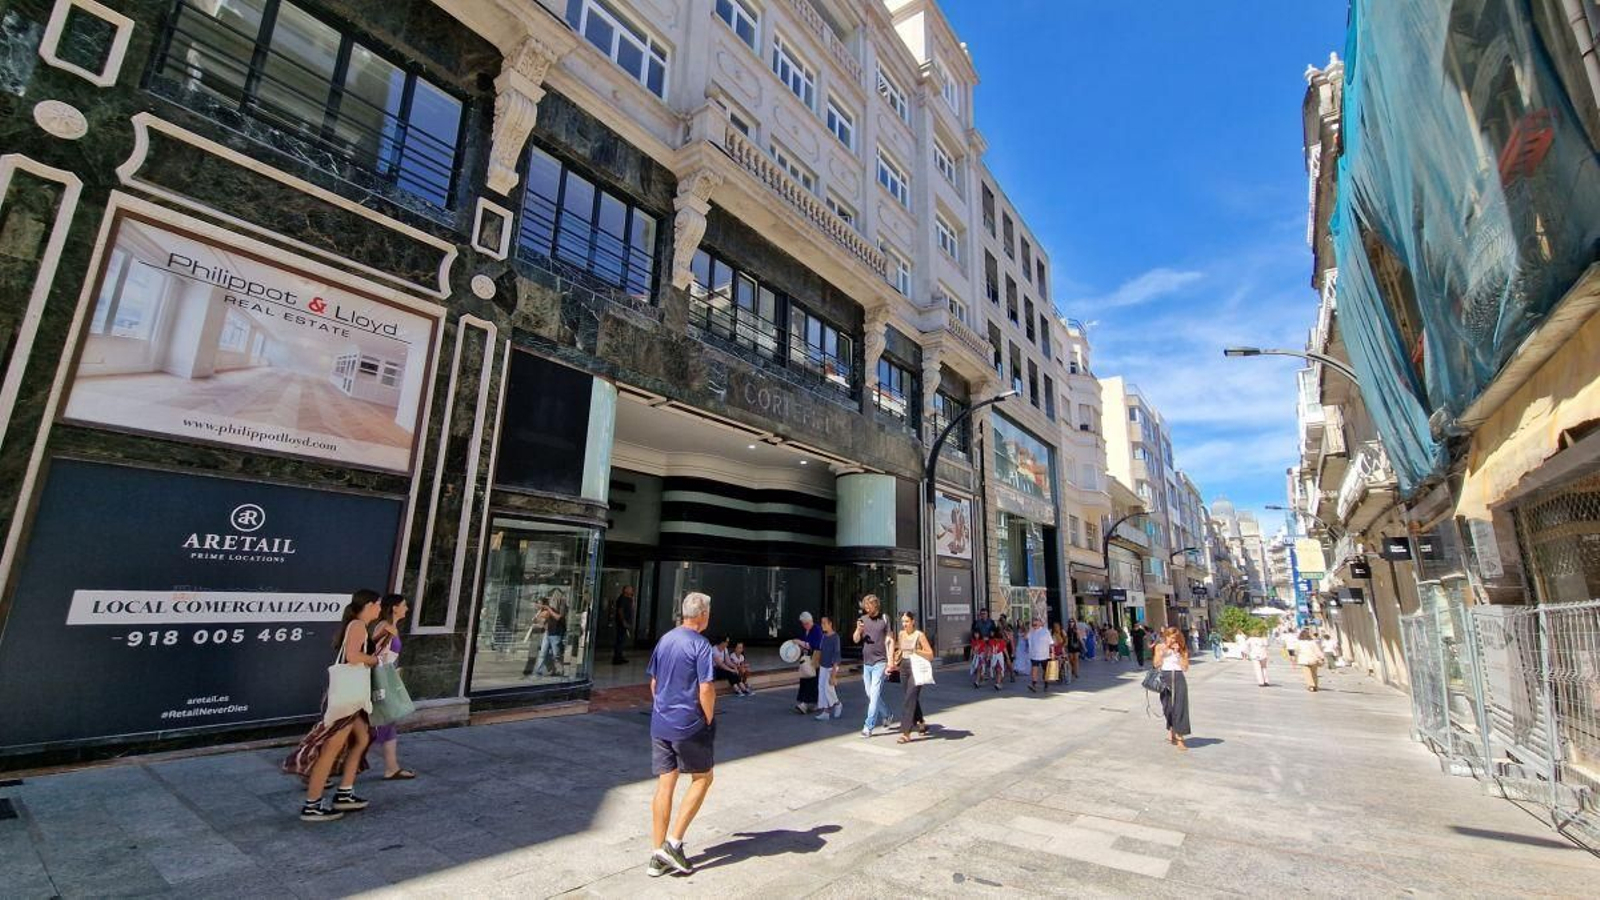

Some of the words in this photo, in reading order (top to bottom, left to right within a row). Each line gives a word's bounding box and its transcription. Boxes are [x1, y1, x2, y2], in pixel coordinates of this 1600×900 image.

[167, 252, 298, 305] Philippot
[308, 297, 327, 314] &
[335, 305, 398, 335] Lloyd
[223, 296, 276, 317] REAL
[283, 313, 350, 338] ESTATE
[183, 418, 337, 451] www.philippotlloyd.com
[182, 533, 296, 554] ARETAIL
[191, 552, 225, 560] PRIME
[229, 554, 285, 563] LOCATIONS
[92, 600, 167, 614] LOCAL
[172, 600, 341, 614] COMERCIALIZADO
[193, 628, 245, 644] 005
[187, 695, 230, 705] aretail.es
[161, 704, 248, 719] #RetailNeverDies
